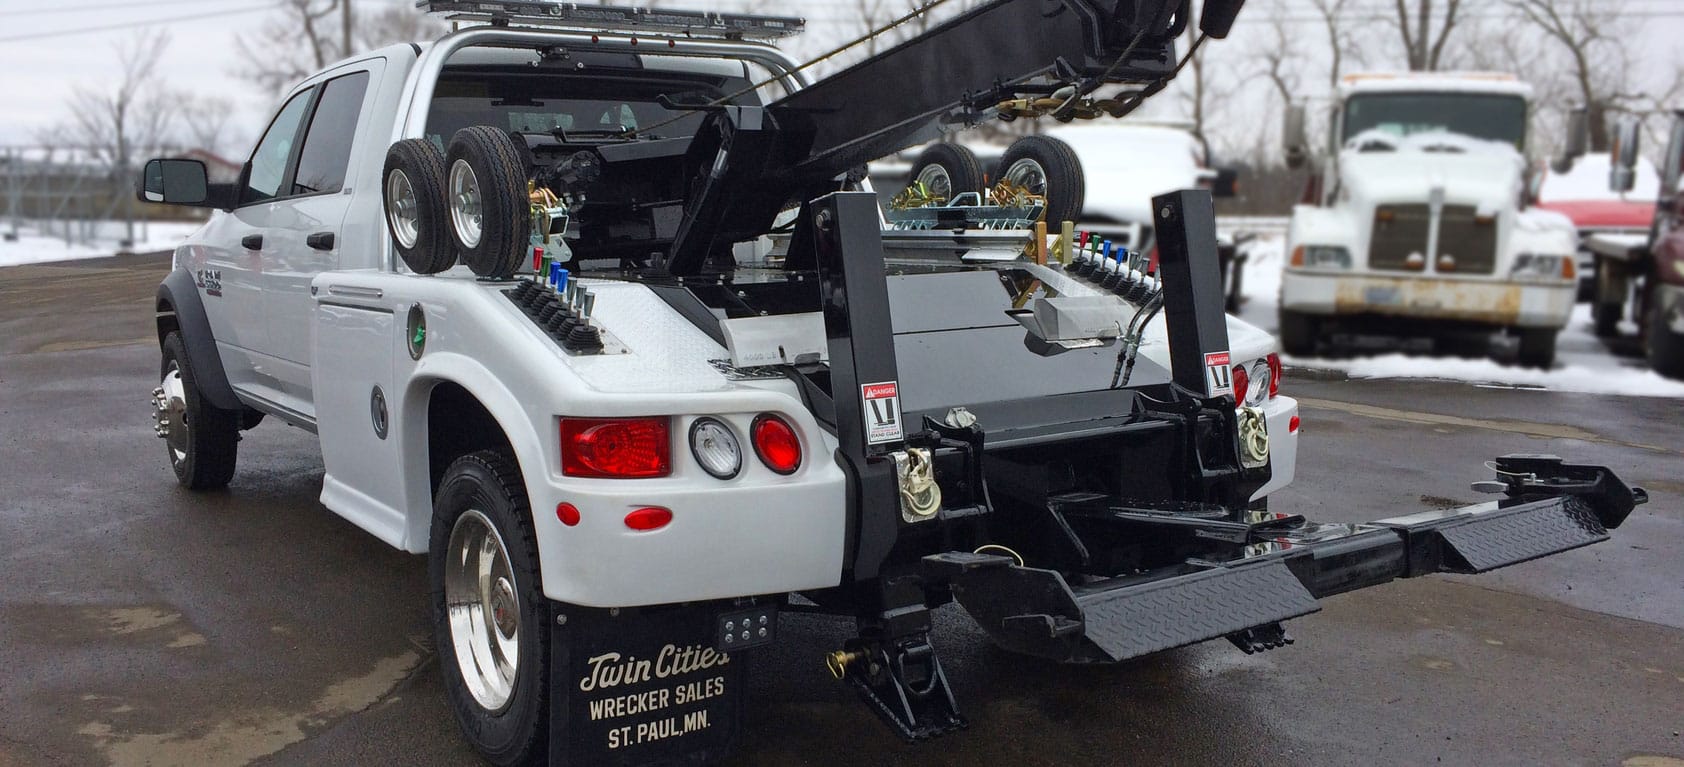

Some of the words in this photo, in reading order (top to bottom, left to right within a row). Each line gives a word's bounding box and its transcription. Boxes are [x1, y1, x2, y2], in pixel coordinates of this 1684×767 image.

[579, 651, 652, 692] Twin
[589, 688, 669, 721] WRECKER
[675, 676, 724, 705] SALES
[608, 726, 634, 749] ST.
